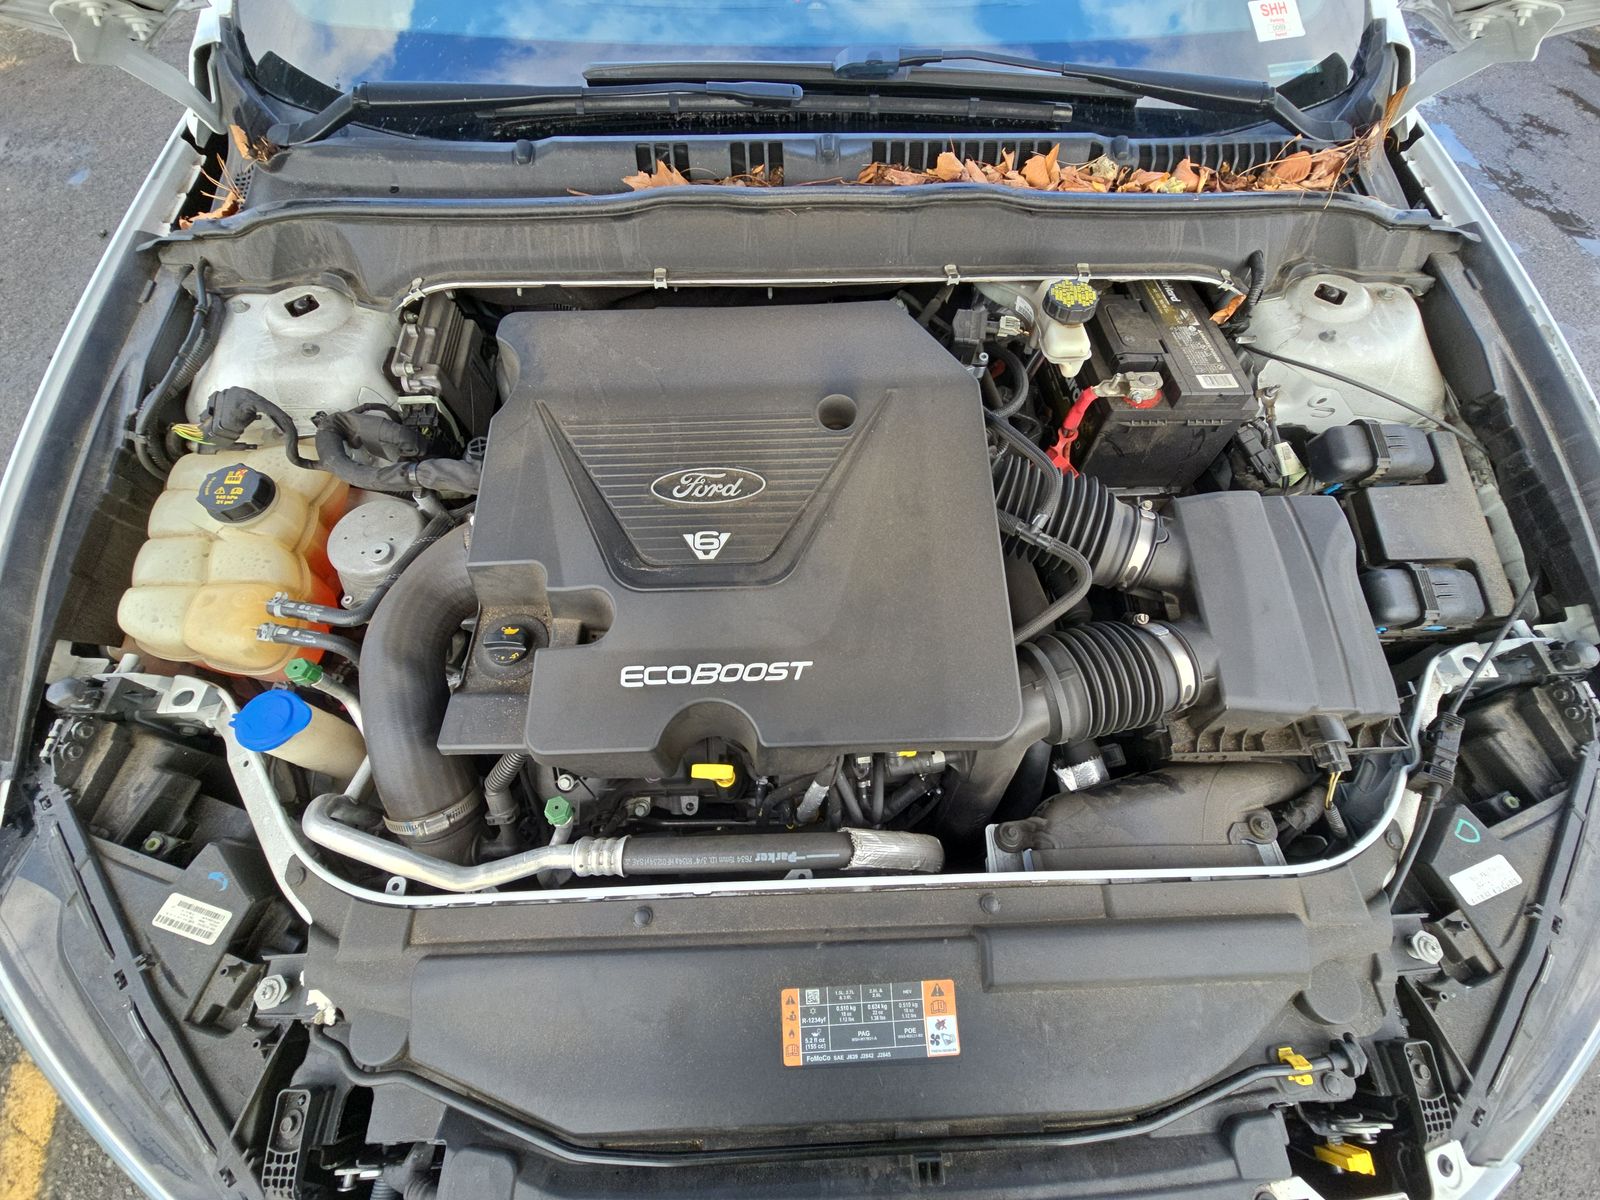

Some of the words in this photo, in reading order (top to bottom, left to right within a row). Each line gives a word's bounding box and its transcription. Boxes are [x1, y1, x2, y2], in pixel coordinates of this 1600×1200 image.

[1260, 1, 1288, 17] SHH
[672, 472, 744, 498] Ford
[620, 660, 813, 688] ECOBOOST
[755, 851, 797, 863] Parker
[802, 1016, 826, 1024] R-1234yf
